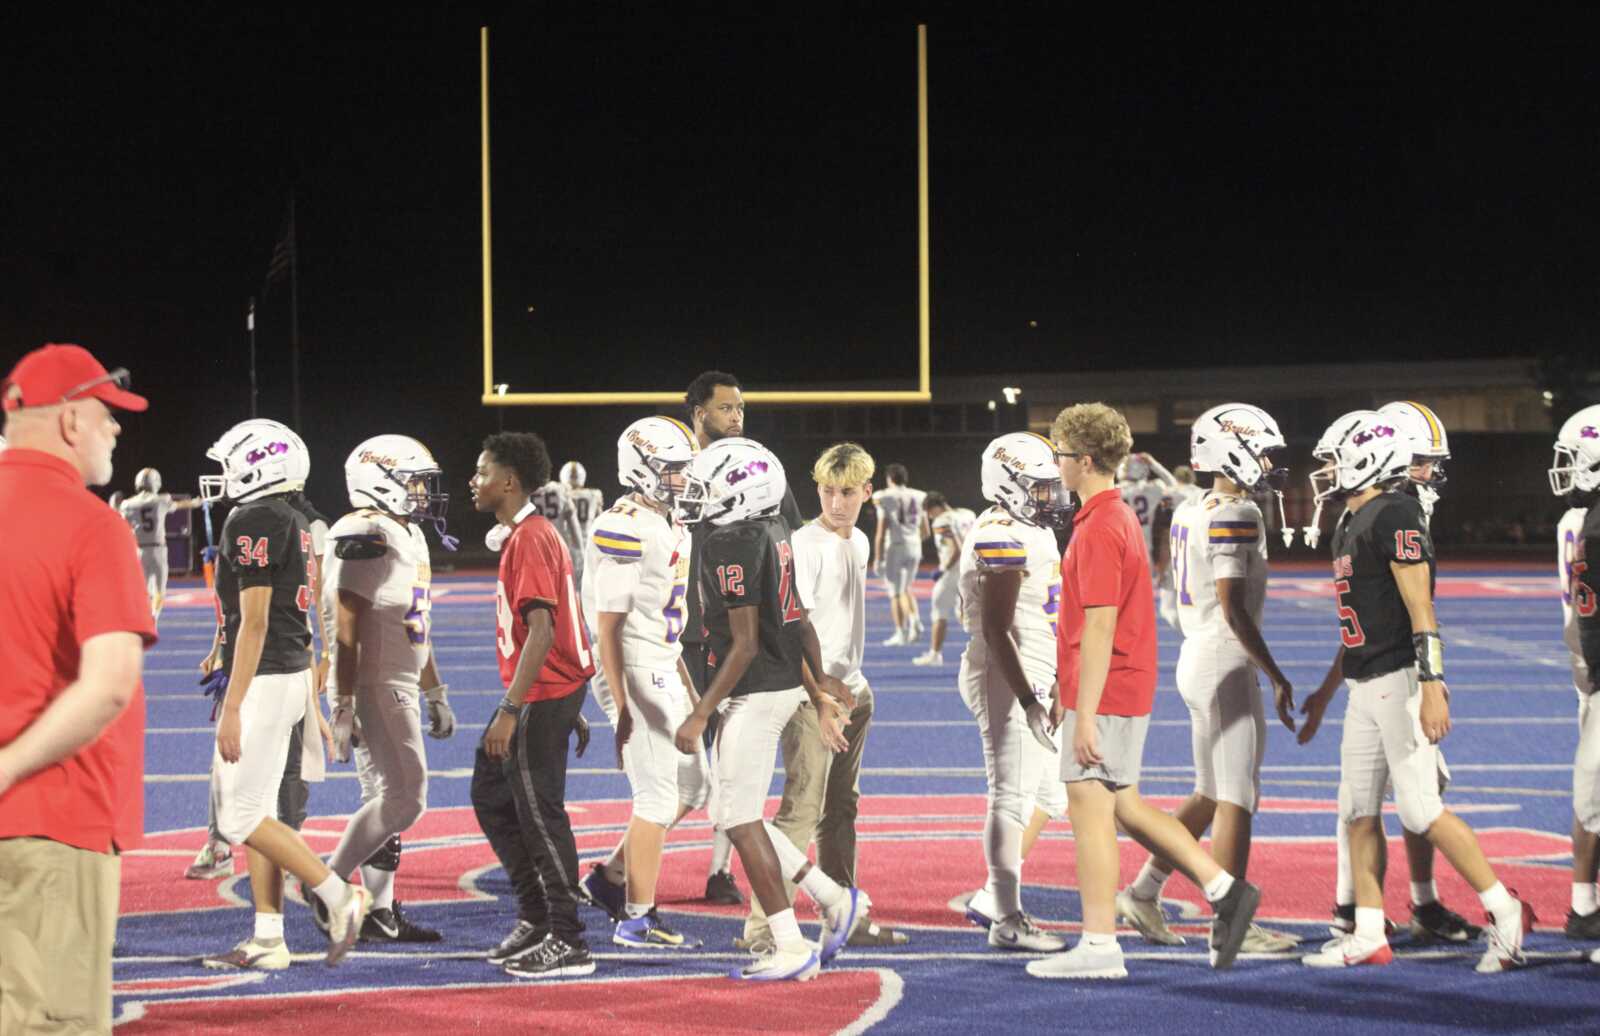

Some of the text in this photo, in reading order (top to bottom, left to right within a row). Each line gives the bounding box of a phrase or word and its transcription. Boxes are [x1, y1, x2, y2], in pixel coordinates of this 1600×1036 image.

[140, 506, 154, 533] 5
[236, 535, 269, 567] 34
[1394, 529, 1422, 560] 15
[717, 564, 745, 596] 12
